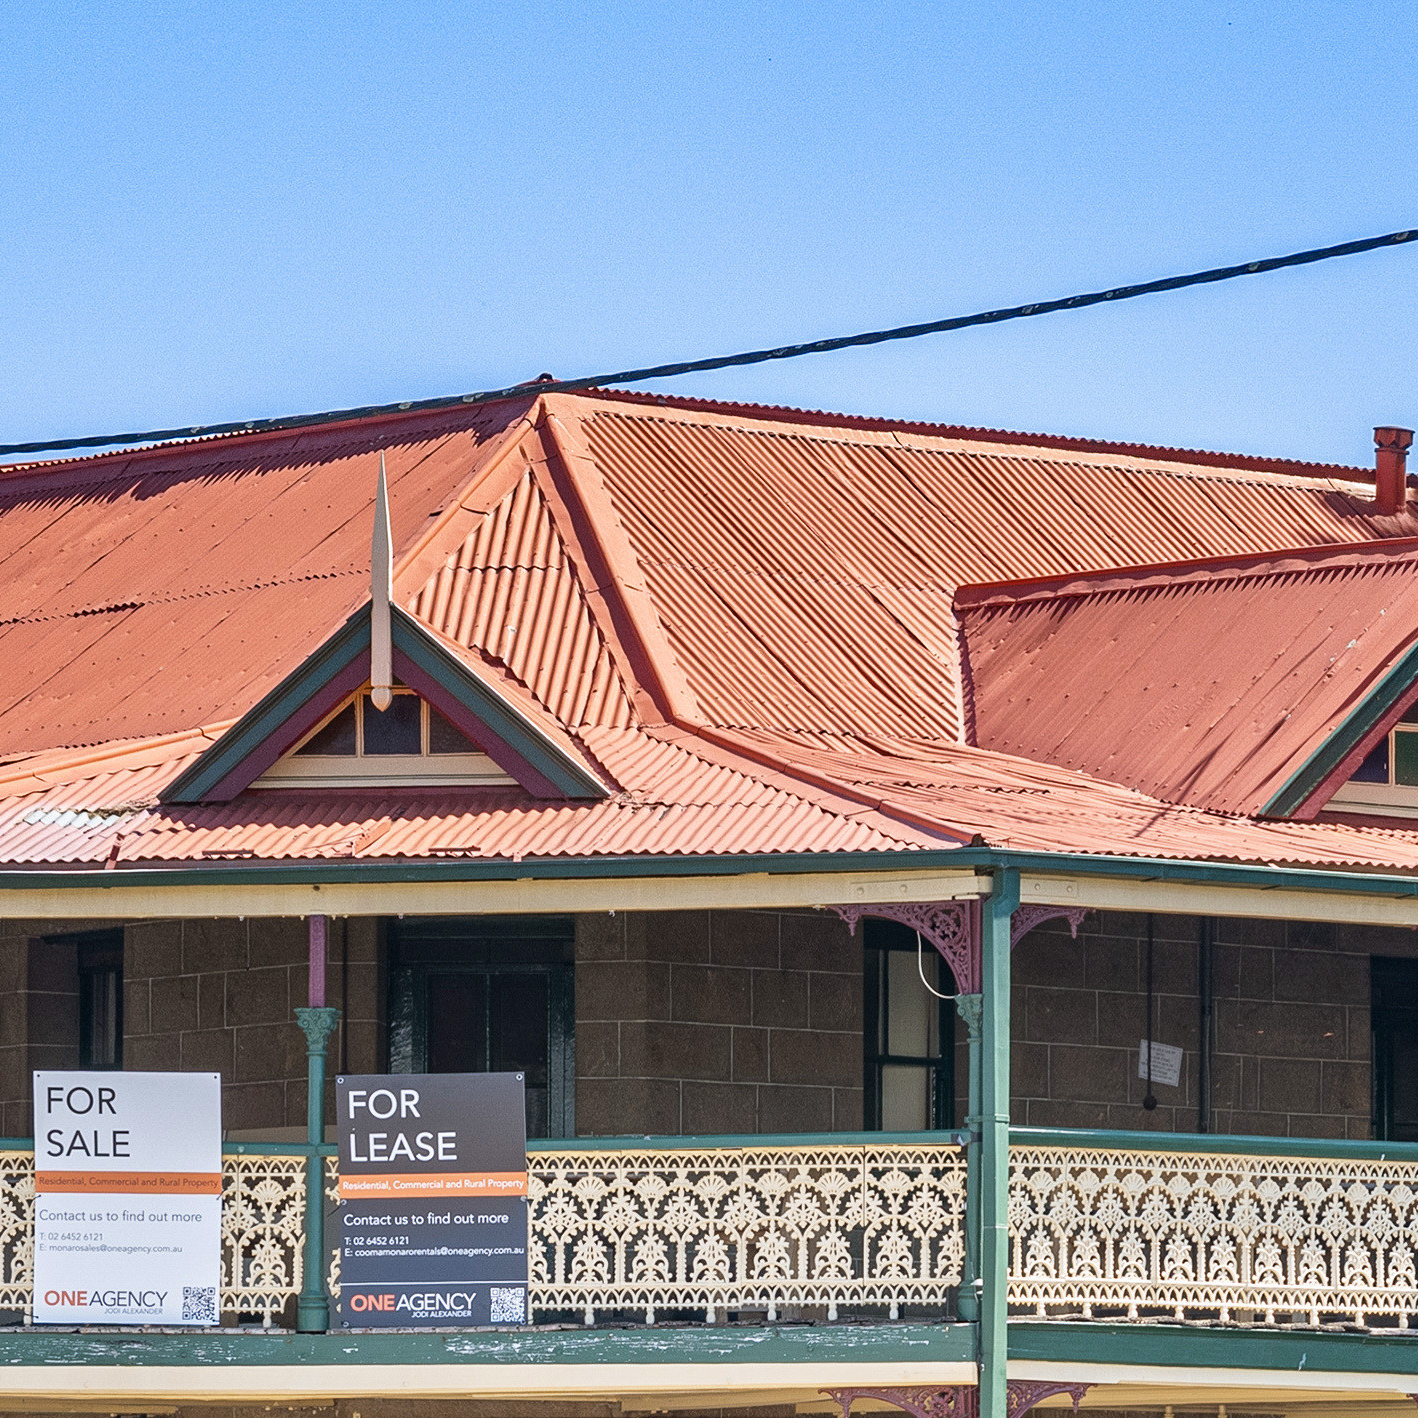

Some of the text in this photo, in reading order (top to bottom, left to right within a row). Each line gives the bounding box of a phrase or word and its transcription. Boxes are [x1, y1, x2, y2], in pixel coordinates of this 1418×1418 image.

[46, 1086, 117, 1115] FOR
[348, 1089, 421, 1119] FOR
[46, 1129, 131, 1158] SALE
[349, 1131, 458, 1162] LEASE
[38, 1177, 219, 1189] Residential, Commercial and Rural Property
[342, 1178, 525, 1191] Residential, Commercial and Rural Property
[39, 1209, 203, 1222] Contact us to find out more
[343, 1212, 510, 1226] Contact us to find out more
[39, 1232, 103, 1241] T: 02 6452 6121
[344, 1236, 409, 1245] T: 02 6452 6121
[39, 1243, 183, 1254] E: monarosales@oneagency.com.au
[344, 1246, 525, 1257] E: coomamonarorentals@oneagency.com.au
[104, 1307, 164, 1315] JODI ALEXANDER
[430, 1310, 472, 1318] ALEXANDER
